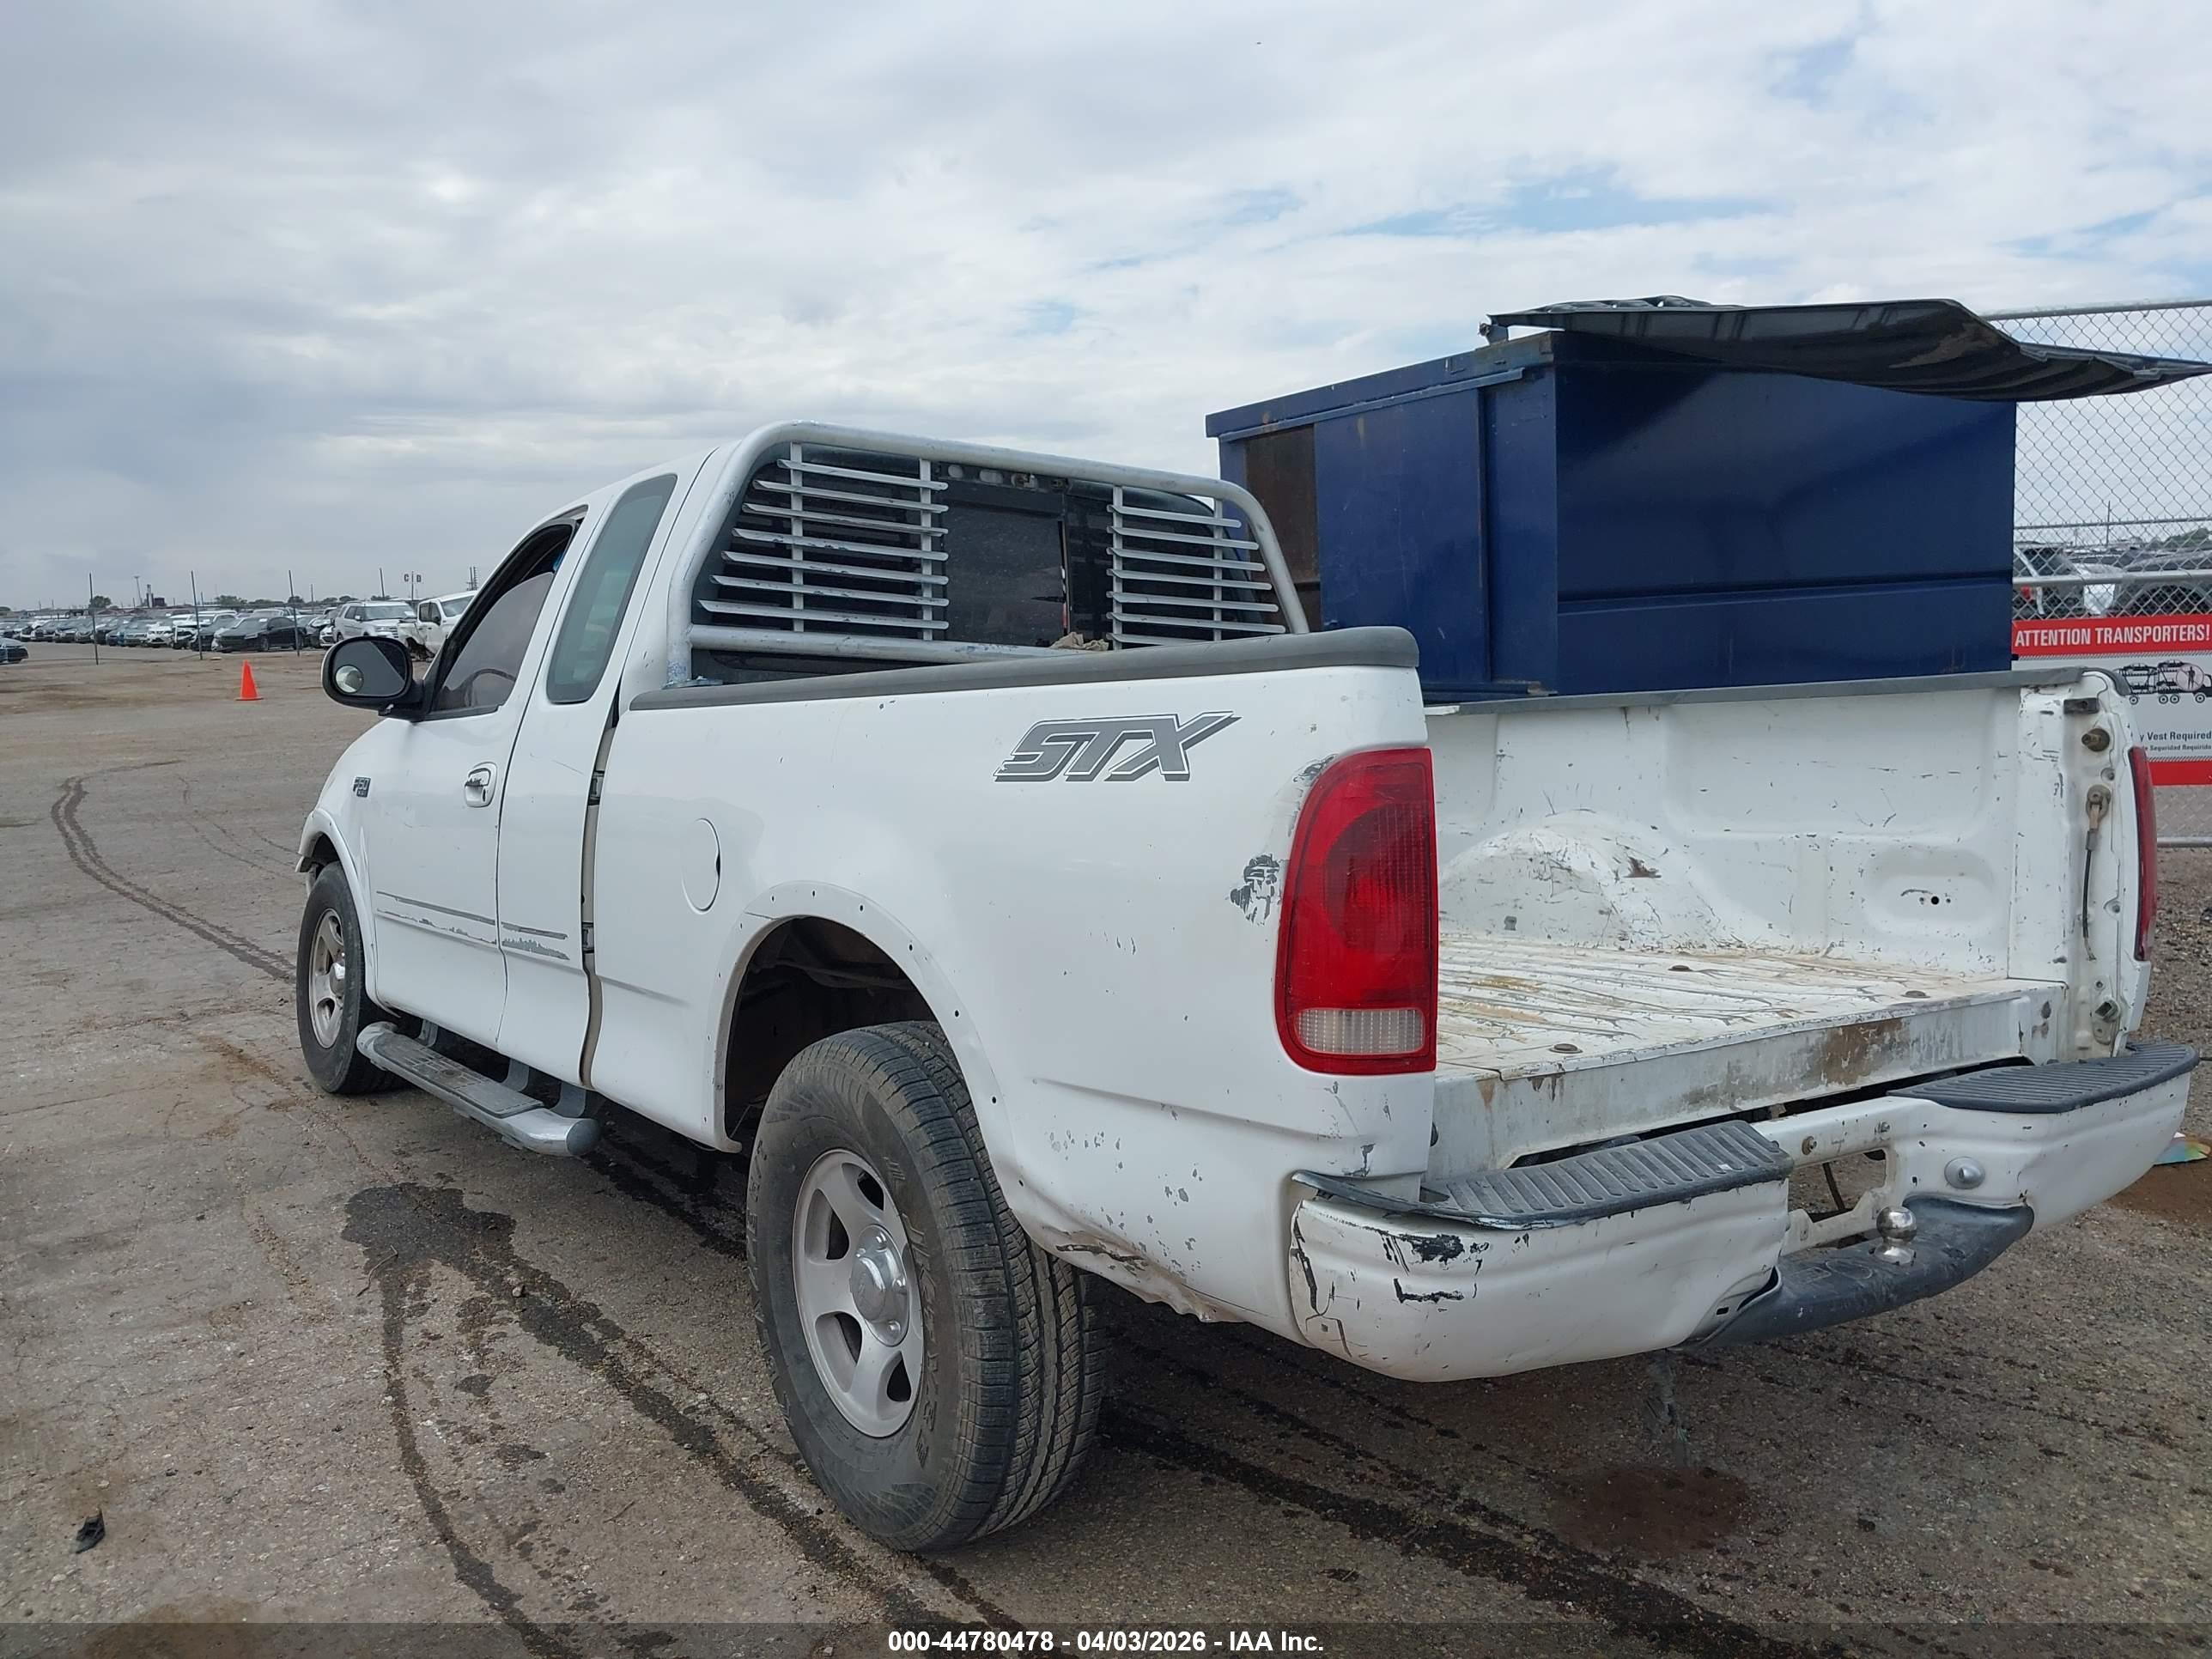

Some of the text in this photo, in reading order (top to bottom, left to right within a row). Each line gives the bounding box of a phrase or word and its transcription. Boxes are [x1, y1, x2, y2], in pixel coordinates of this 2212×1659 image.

[2014, 623, 2211, 647] ATTENTION TRANSPORTERS!
[994, 710, 1243, 782] STX
[2147, 732, 2167, 741] Vest
[2170, 730, 2212, 742] Required
